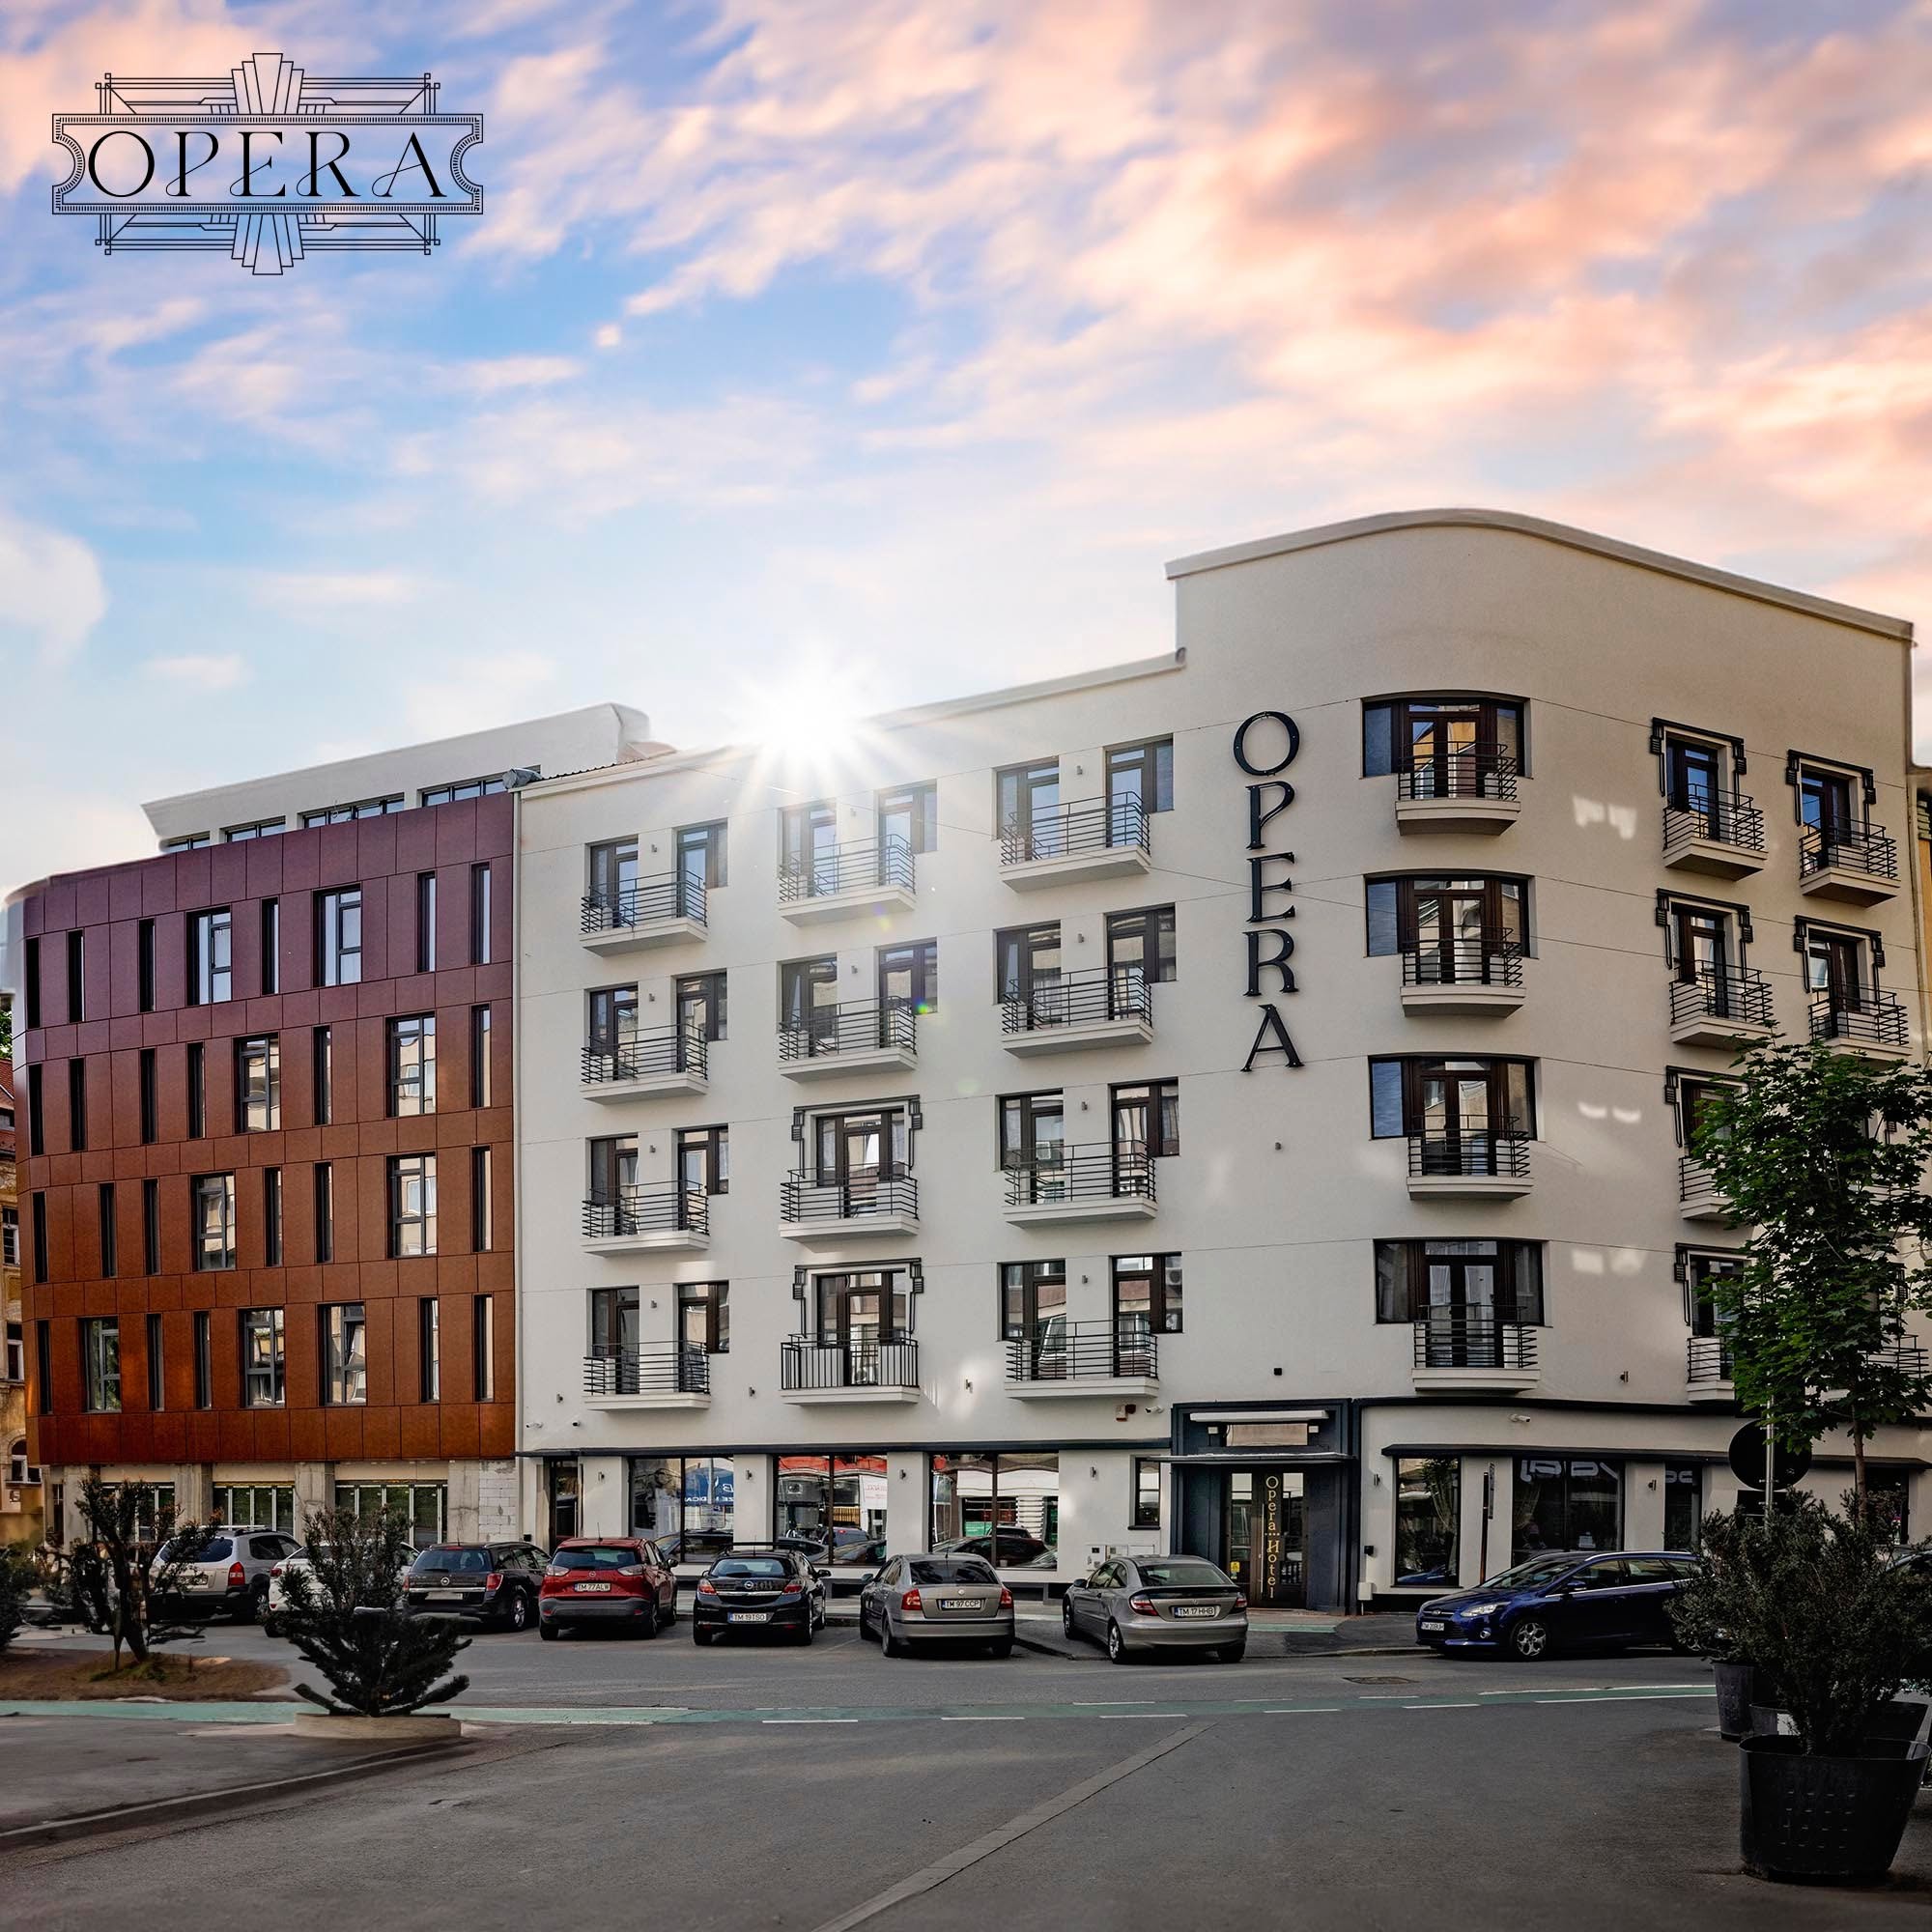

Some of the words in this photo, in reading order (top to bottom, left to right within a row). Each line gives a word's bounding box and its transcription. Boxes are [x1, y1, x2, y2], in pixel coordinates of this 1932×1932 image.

[1233, 711, 1304, 1072] OPERA
[1265, 1476, 1279, 1531] Opera
[1266, 1540, 1279, 1599] Hotel
